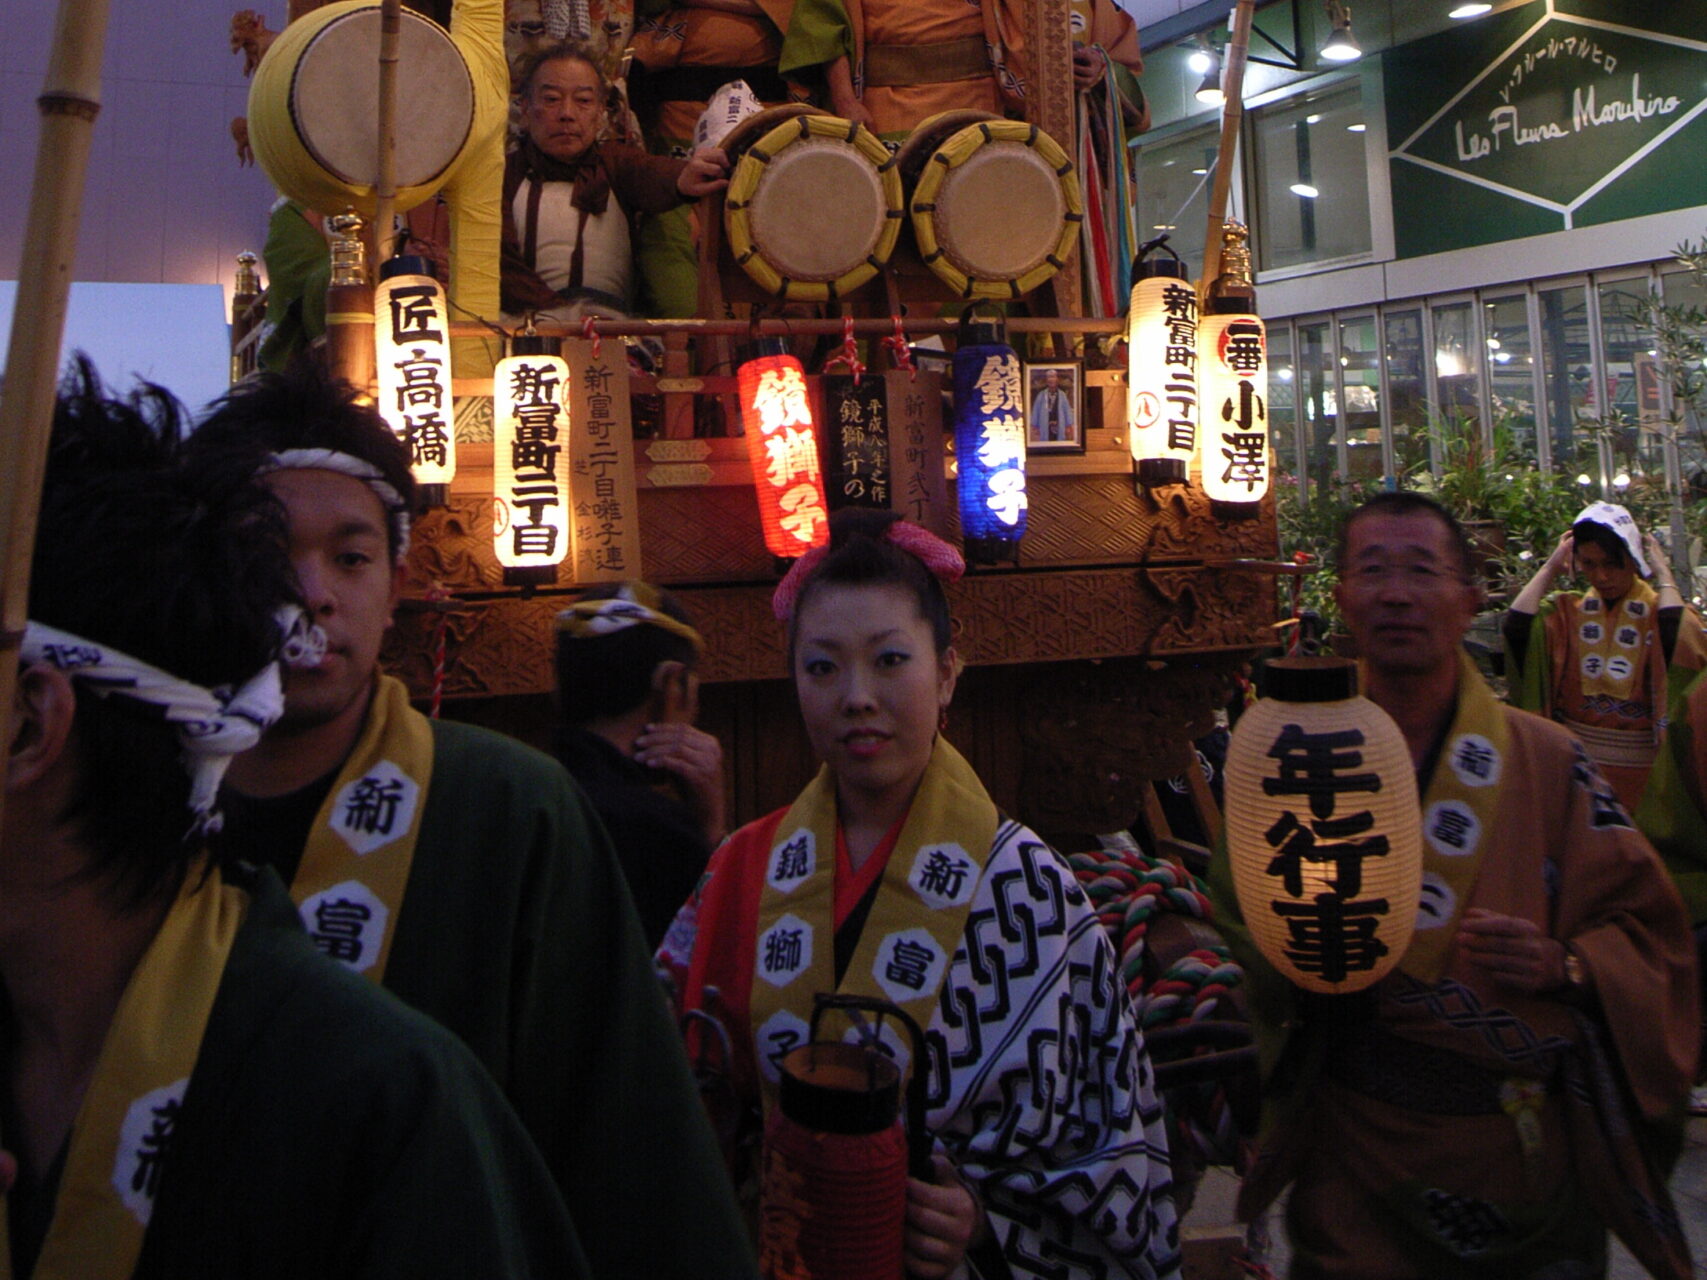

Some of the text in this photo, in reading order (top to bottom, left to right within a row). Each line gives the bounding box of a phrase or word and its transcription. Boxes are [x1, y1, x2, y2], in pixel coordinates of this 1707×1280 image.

[1455, 120, 1490, 161] Les
[1489, 105, 1569, 151] Fleurs
[389, 286, 448, 468] 匠高橋
[753, 366, 826, 542] 鏡獅子
[976, 354, 1028, 526] 鏡獅子
[1162, 283, 1197, 451] 新富町二丁目
[510, 363, 561, 557] 新富町二丁目
[584, 365, 626, 572] 新富町二丁目囃子連
[1261, 723, 1390, 984] 年行事
